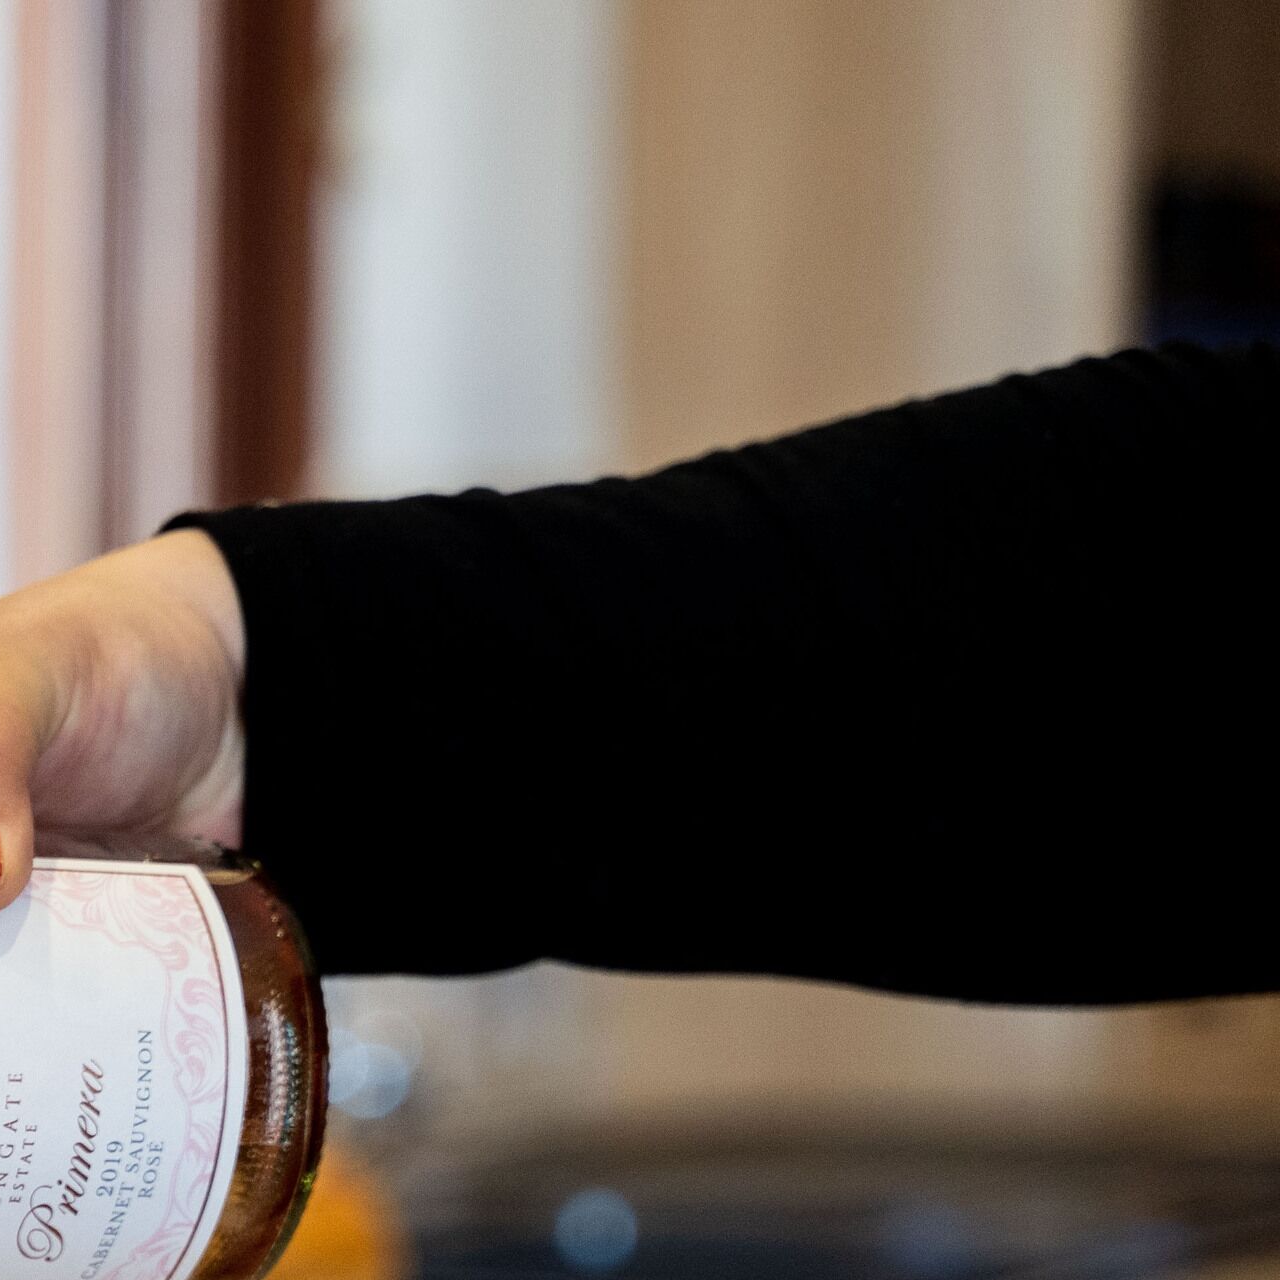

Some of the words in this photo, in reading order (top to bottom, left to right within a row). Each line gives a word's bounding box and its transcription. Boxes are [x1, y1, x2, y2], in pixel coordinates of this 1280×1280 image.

[9, 1124, 38, 1204] ESTATE
[16, 1058, 104, 1262] Primera
[80, 1182, 135, 1280] CABERNET
[125, 1029, 153, 1173] SAUVIGNON
[96, 1140, 124, 1197] 2019
